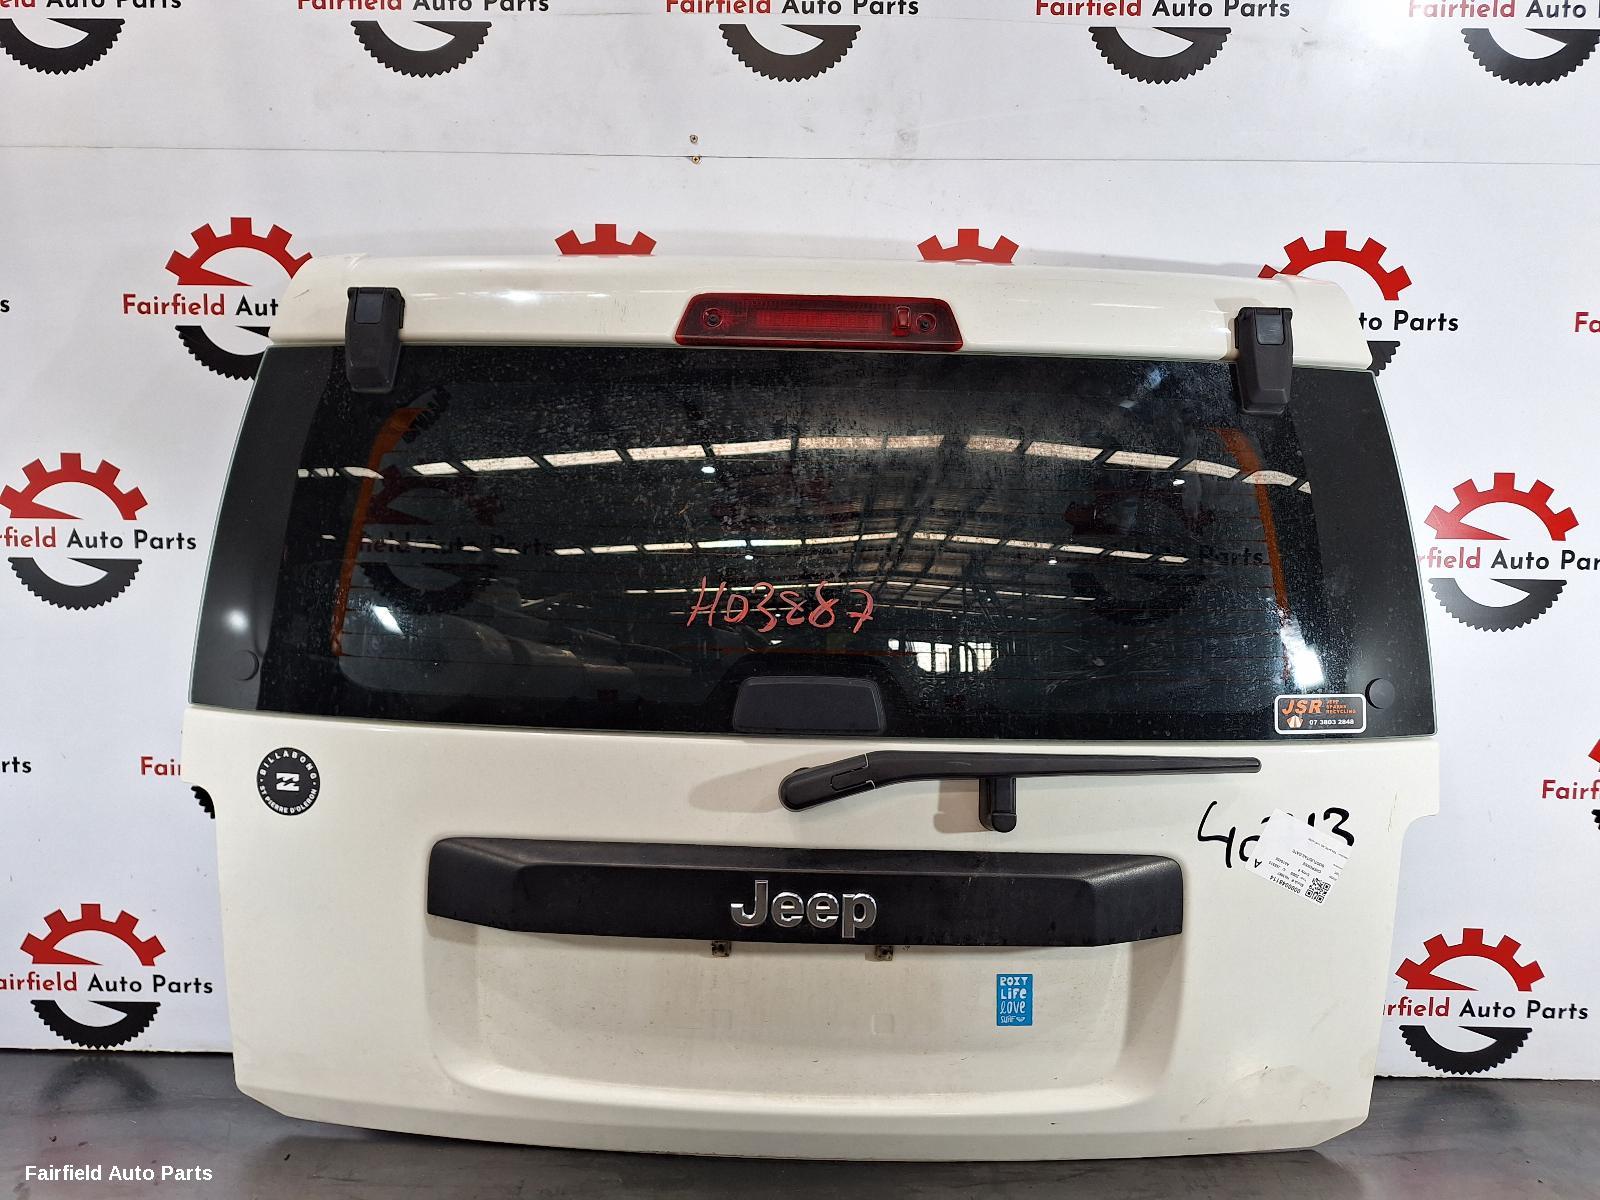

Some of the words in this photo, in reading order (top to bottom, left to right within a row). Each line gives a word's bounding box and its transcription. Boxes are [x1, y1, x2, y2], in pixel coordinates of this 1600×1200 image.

[666, 0, 770, 14] Fairfield
[782, 0, 842, 15] Auto
[853, 0, 919, 15] Parts
[1036, 0, 1141, 17] Fairfield
[1152, 0, 1213, 17] Auto
[1224, 0, 1290, 17] Parts
[1409, 0, 1516, 18] Fairfield
[1526, 0, 1587, 18] Auto
[122, 293, 225, 316] Fairfield
[235, 294, 279, 316] Aut
[1359, 312, 1383, 331] to
[1394, 309, 1459, 332] Parts
[0, 526, 56, 548] field
[66, 528, 123, 548] Auto
[134, 529, 197, 550] Parts
[1418, 546, 1481, 569] rfield
[1491, 548, 1549, 570] Auto
[1561, 550, 1600, 570] Par
[1281, 699, 1323, 715] JSR
[1, 756, 32, 774] rts
[259, 750, 318, 780] BILLABONG
[1541, 779, 1600, 800] Fairf
[264, 795, 289, 814] PIERRE
[730, 879, 877, 939] Jeep
[0, 971, 78, 991] airfield
[87, 973, 142, 992] Auto
[152, 974, 213, 994] Parts
[1383, 997, 1450, 1017] rfield
[1459, 998, 1516, 1018] Auto
[1527, 1000, 1589, 1020] Parts
